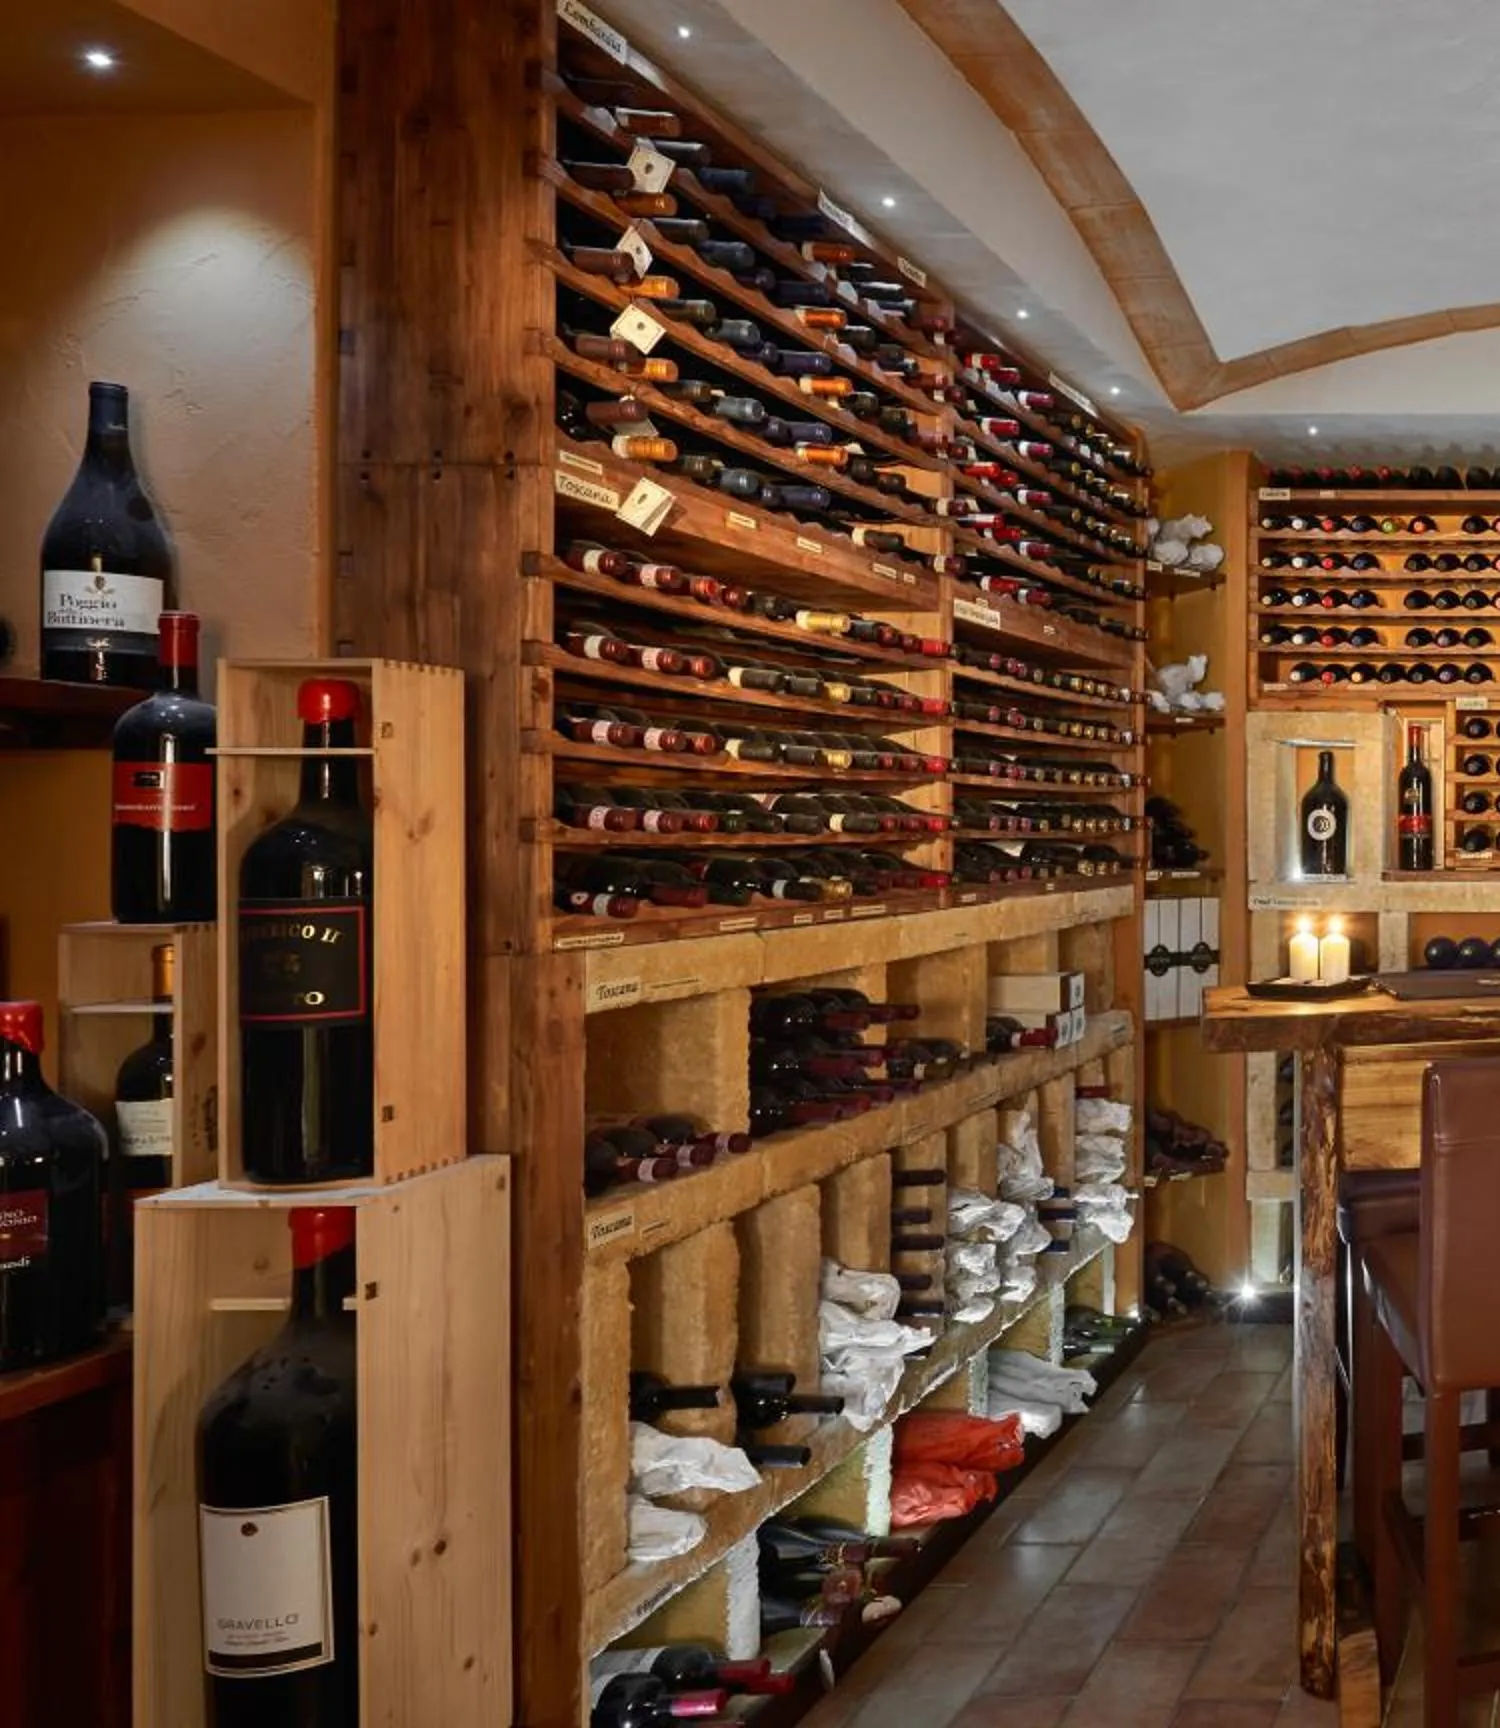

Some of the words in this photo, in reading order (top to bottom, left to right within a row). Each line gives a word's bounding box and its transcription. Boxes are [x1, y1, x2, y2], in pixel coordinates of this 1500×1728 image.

[559, 475, 613, 504] Toscana
[60, 593, 117, 609] Poggio
[217, 1613, 299, 1631] GRAVELLO
